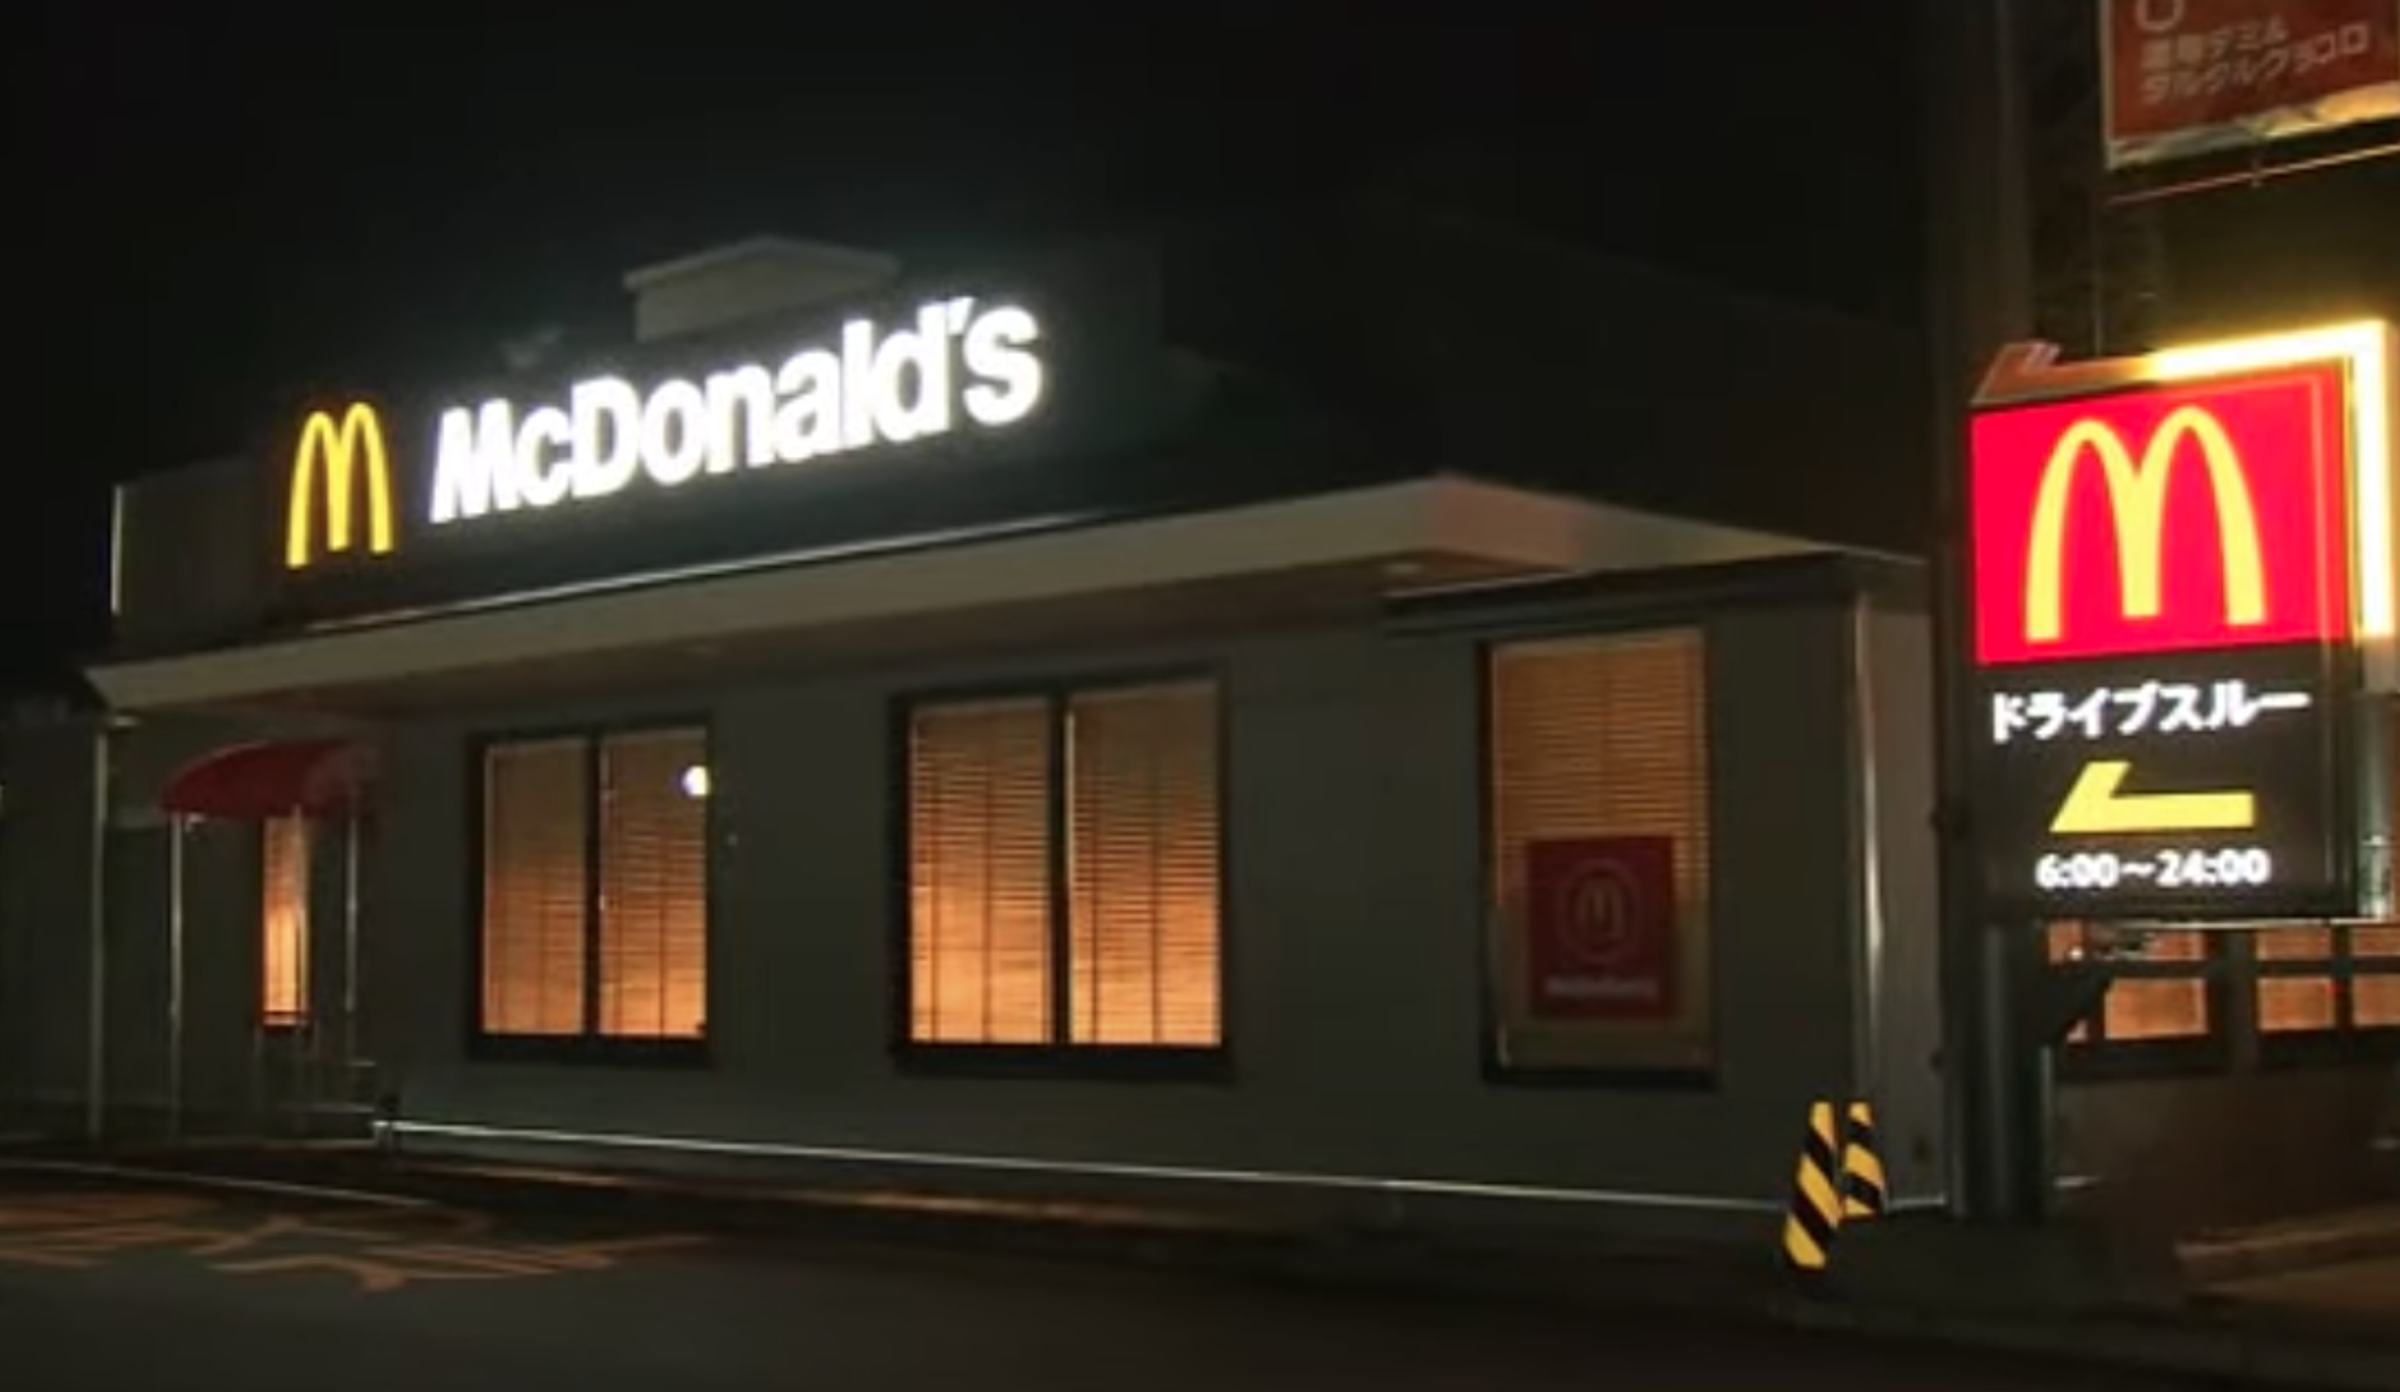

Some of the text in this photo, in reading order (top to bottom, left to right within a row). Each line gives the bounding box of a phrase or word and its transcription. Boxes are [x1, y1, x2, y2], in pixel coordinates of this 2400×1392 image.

[428, 295, 1044, 524] McDonald's
[1993, 679, 2310, 743] ドライブスルー
